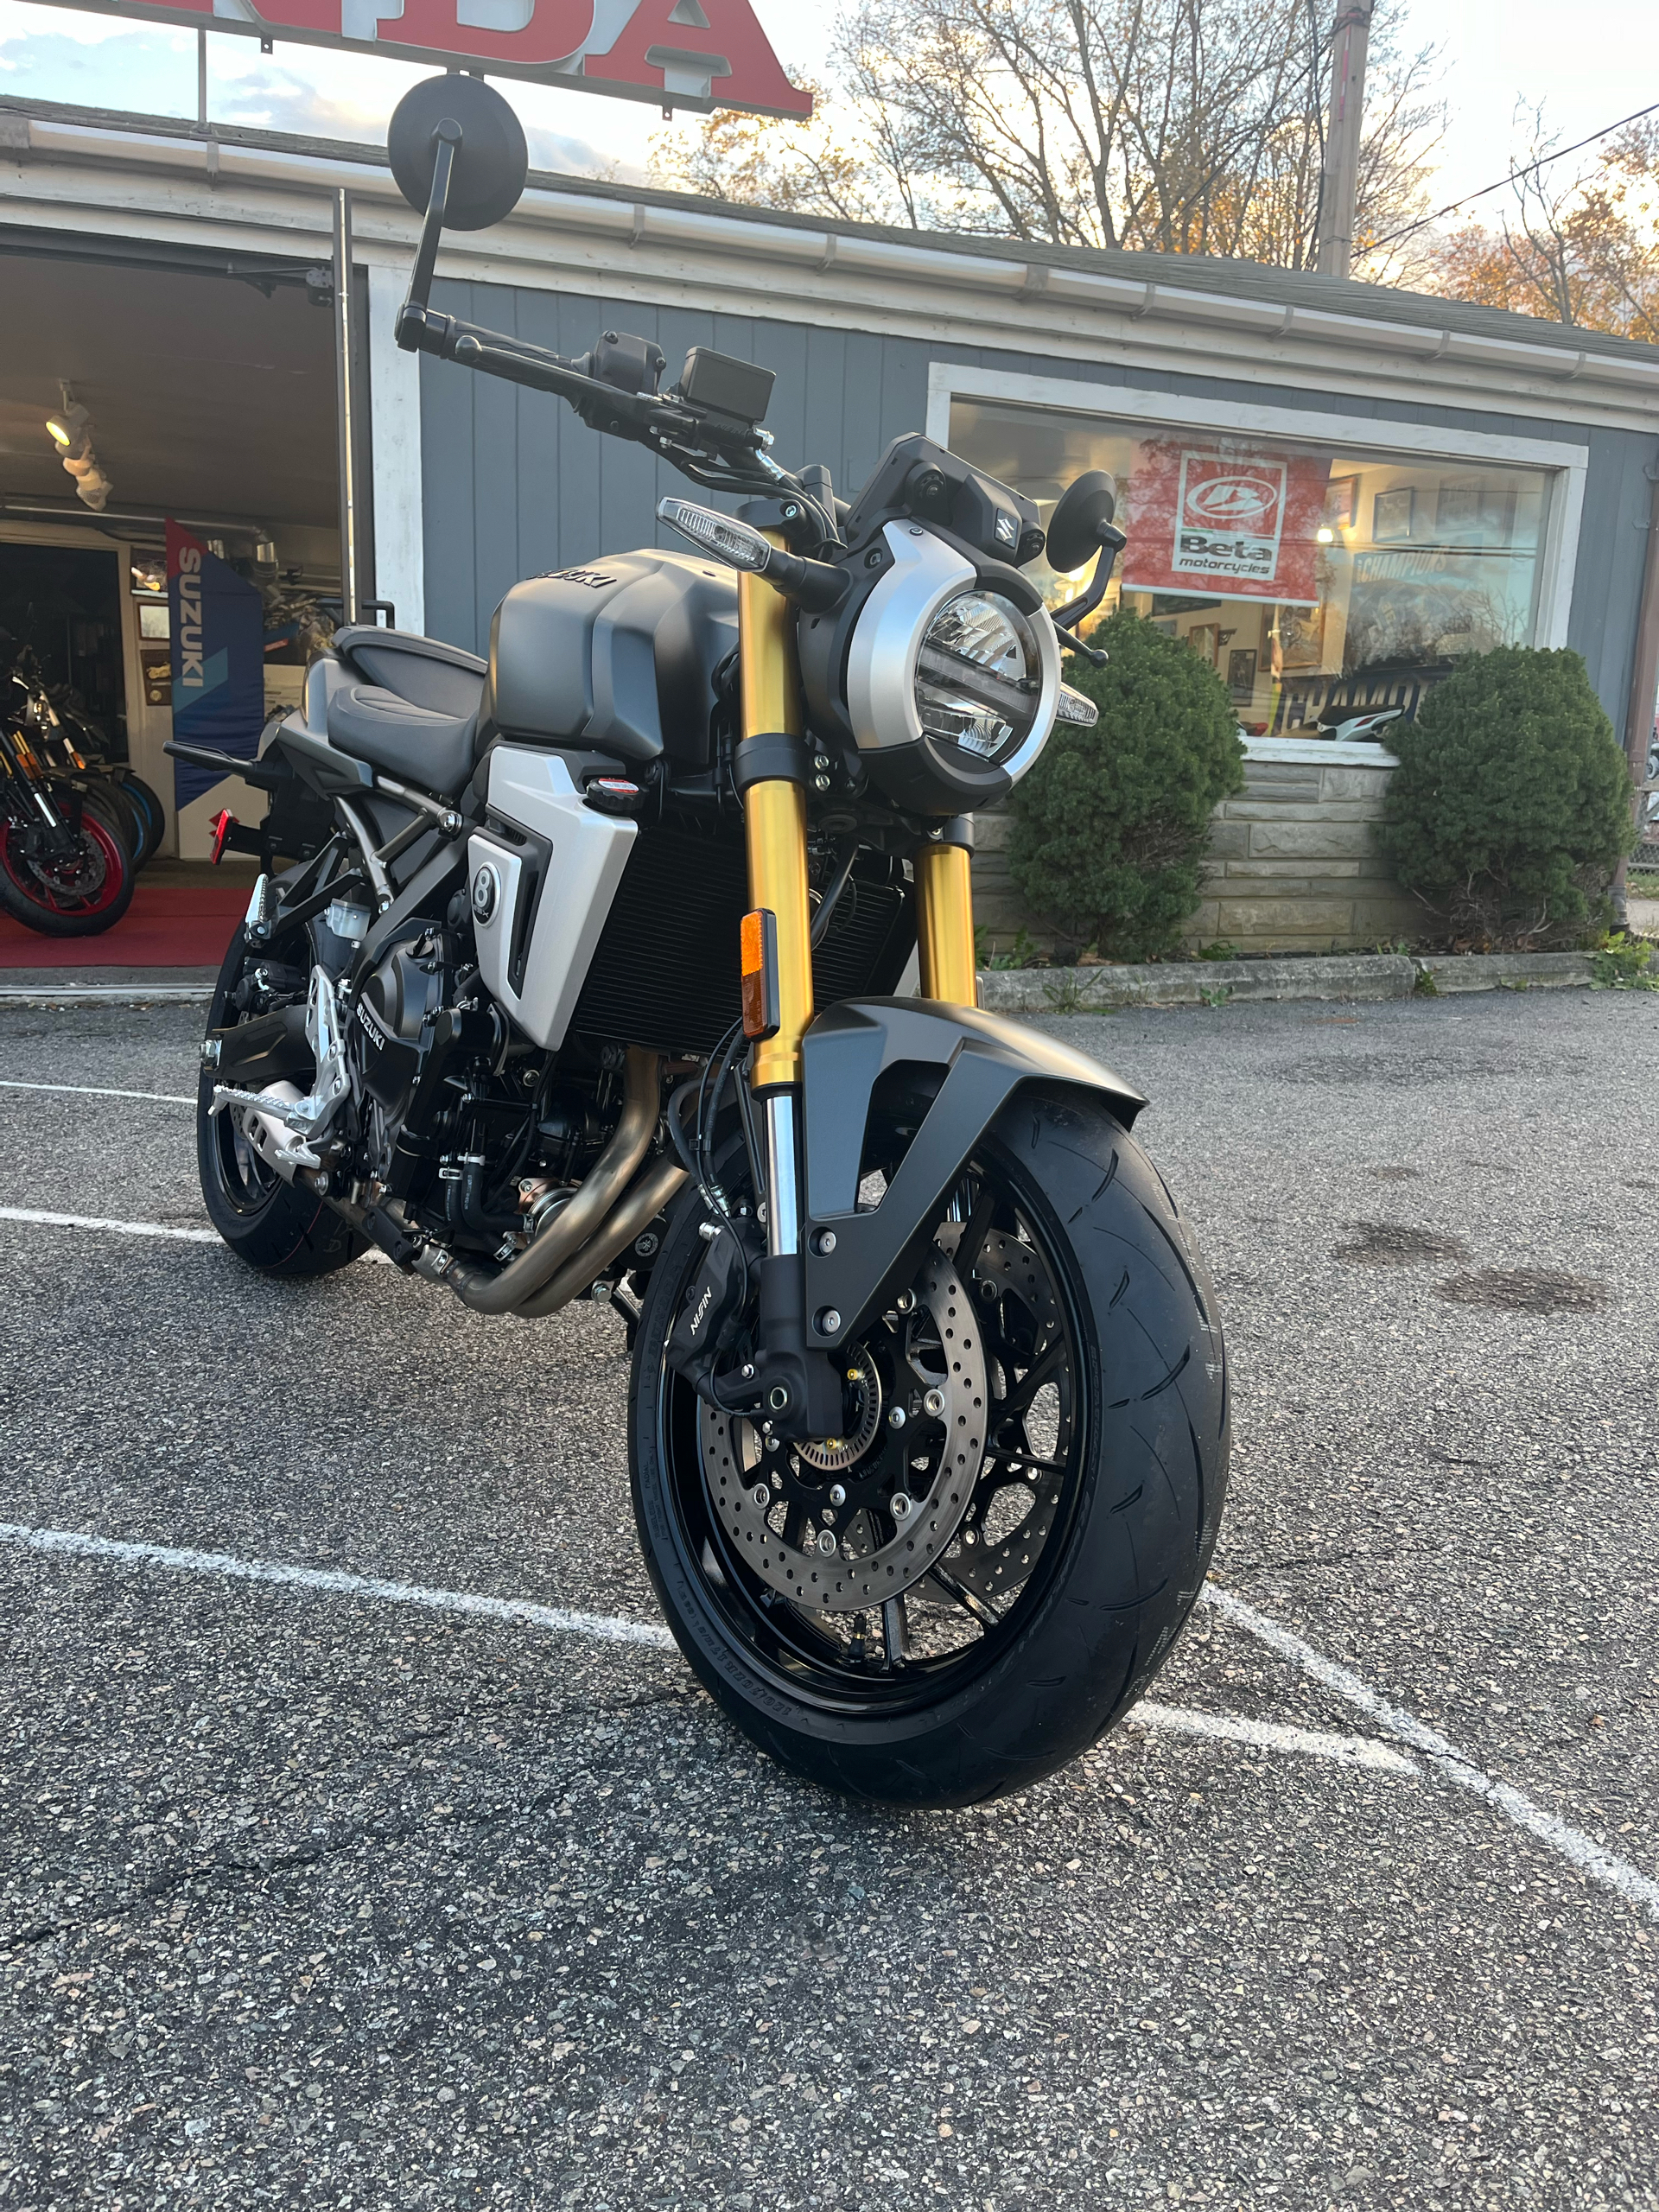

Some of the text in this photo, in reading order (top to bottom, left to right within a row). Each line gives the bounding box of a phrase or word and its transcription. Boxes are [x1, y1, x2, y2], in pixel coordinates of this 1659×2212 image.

[1179, 534, 1273, 562] Beta
[1179, 557, 1270, 575] motorcycles
[179, 546, 204, 687] SUZUKI
[474, 870, 490, 908] 8
[357, 1002, 385, 1051] SUZUKI
